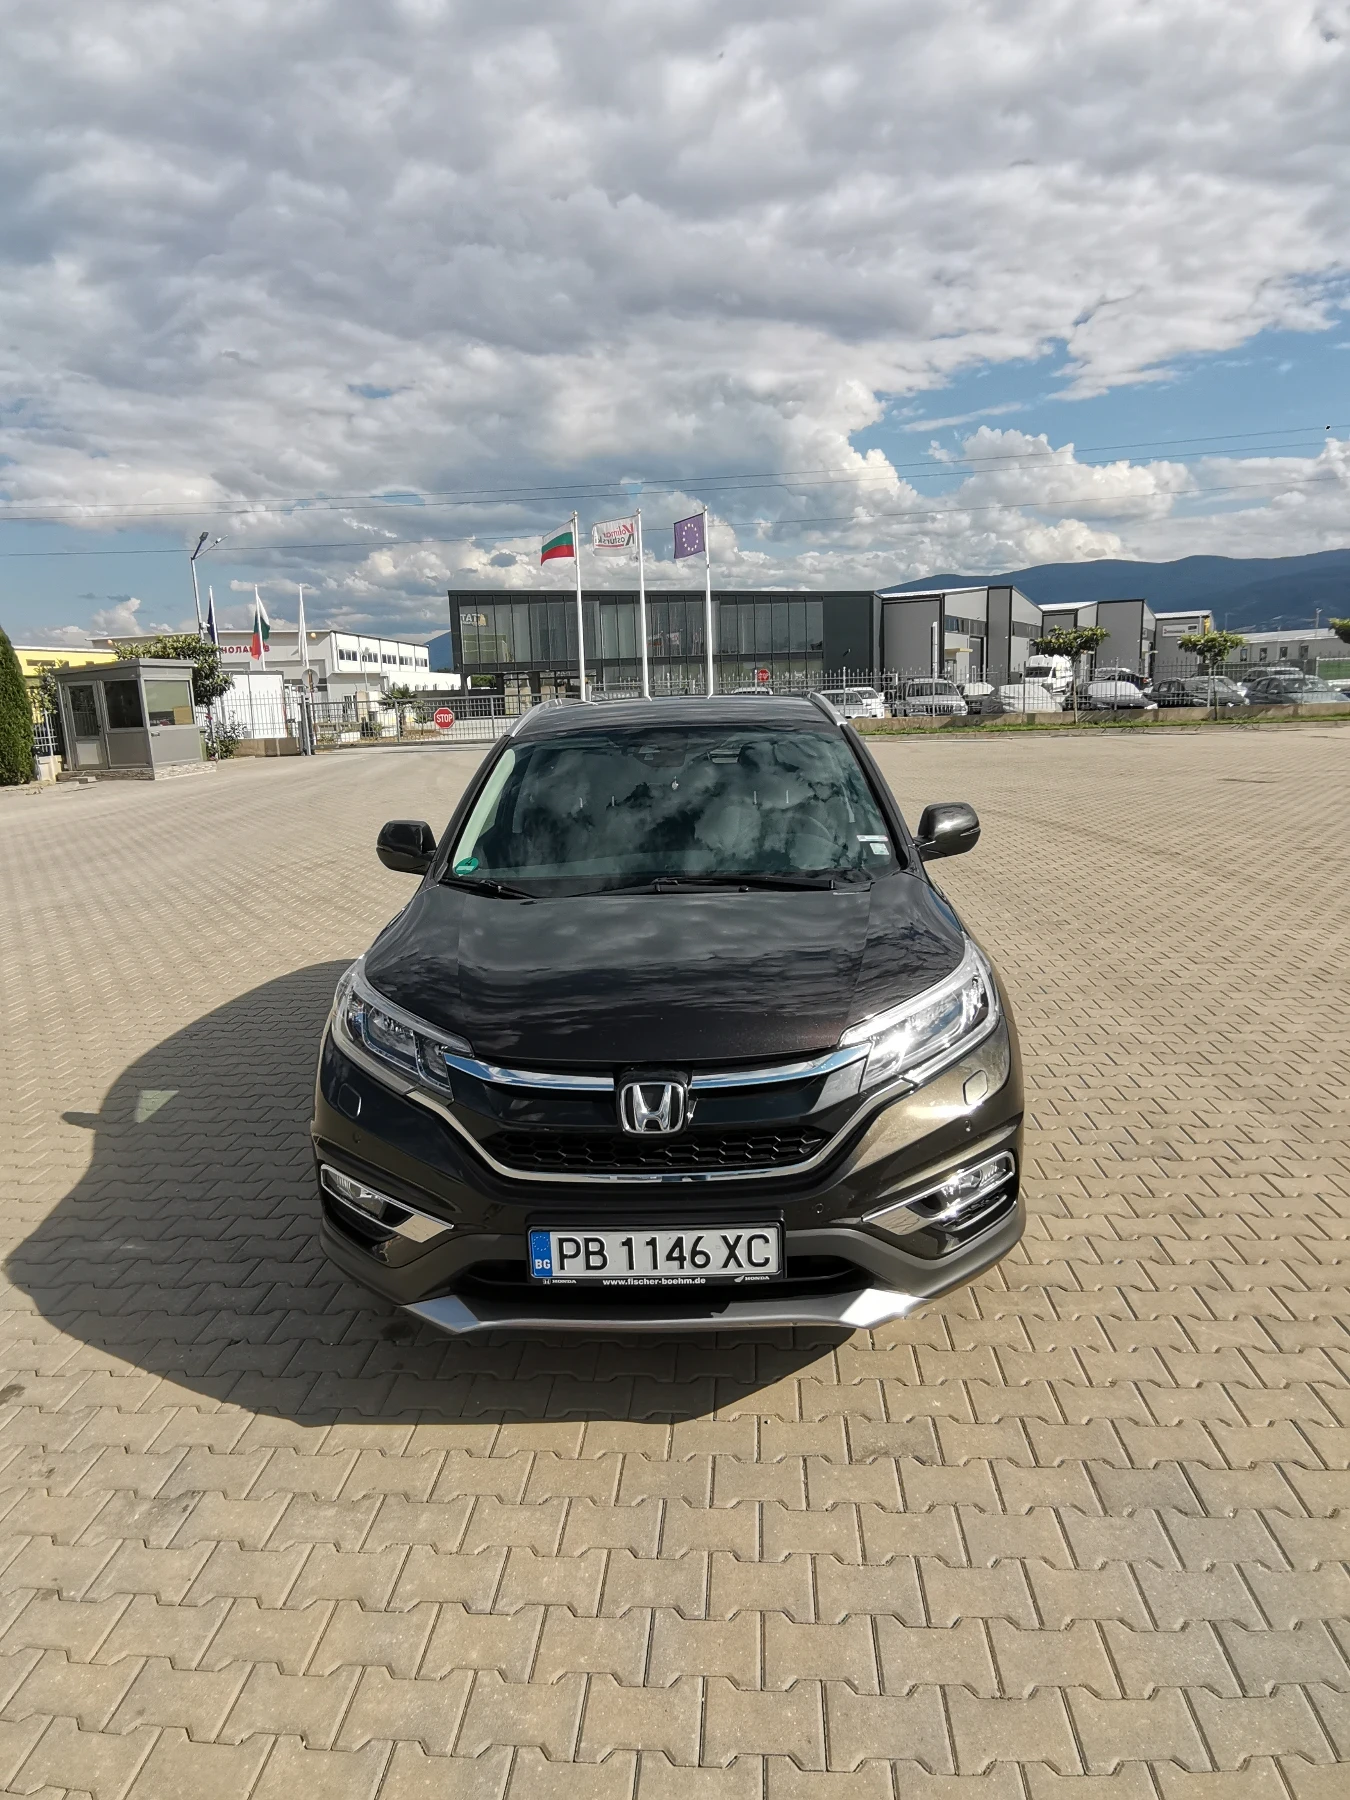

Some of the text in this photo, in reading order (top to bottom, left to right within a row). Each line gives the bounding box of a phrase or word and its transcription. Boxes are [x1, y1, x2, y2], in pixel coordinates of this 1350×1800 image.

[436, 713, 453, 723] STOP
[557, 1233, 772, 1271] PB 1146 XC
[534, 1258, 551, 1270] BG
[602, 1277, 706, 1286] www.fischer-boehm.de
